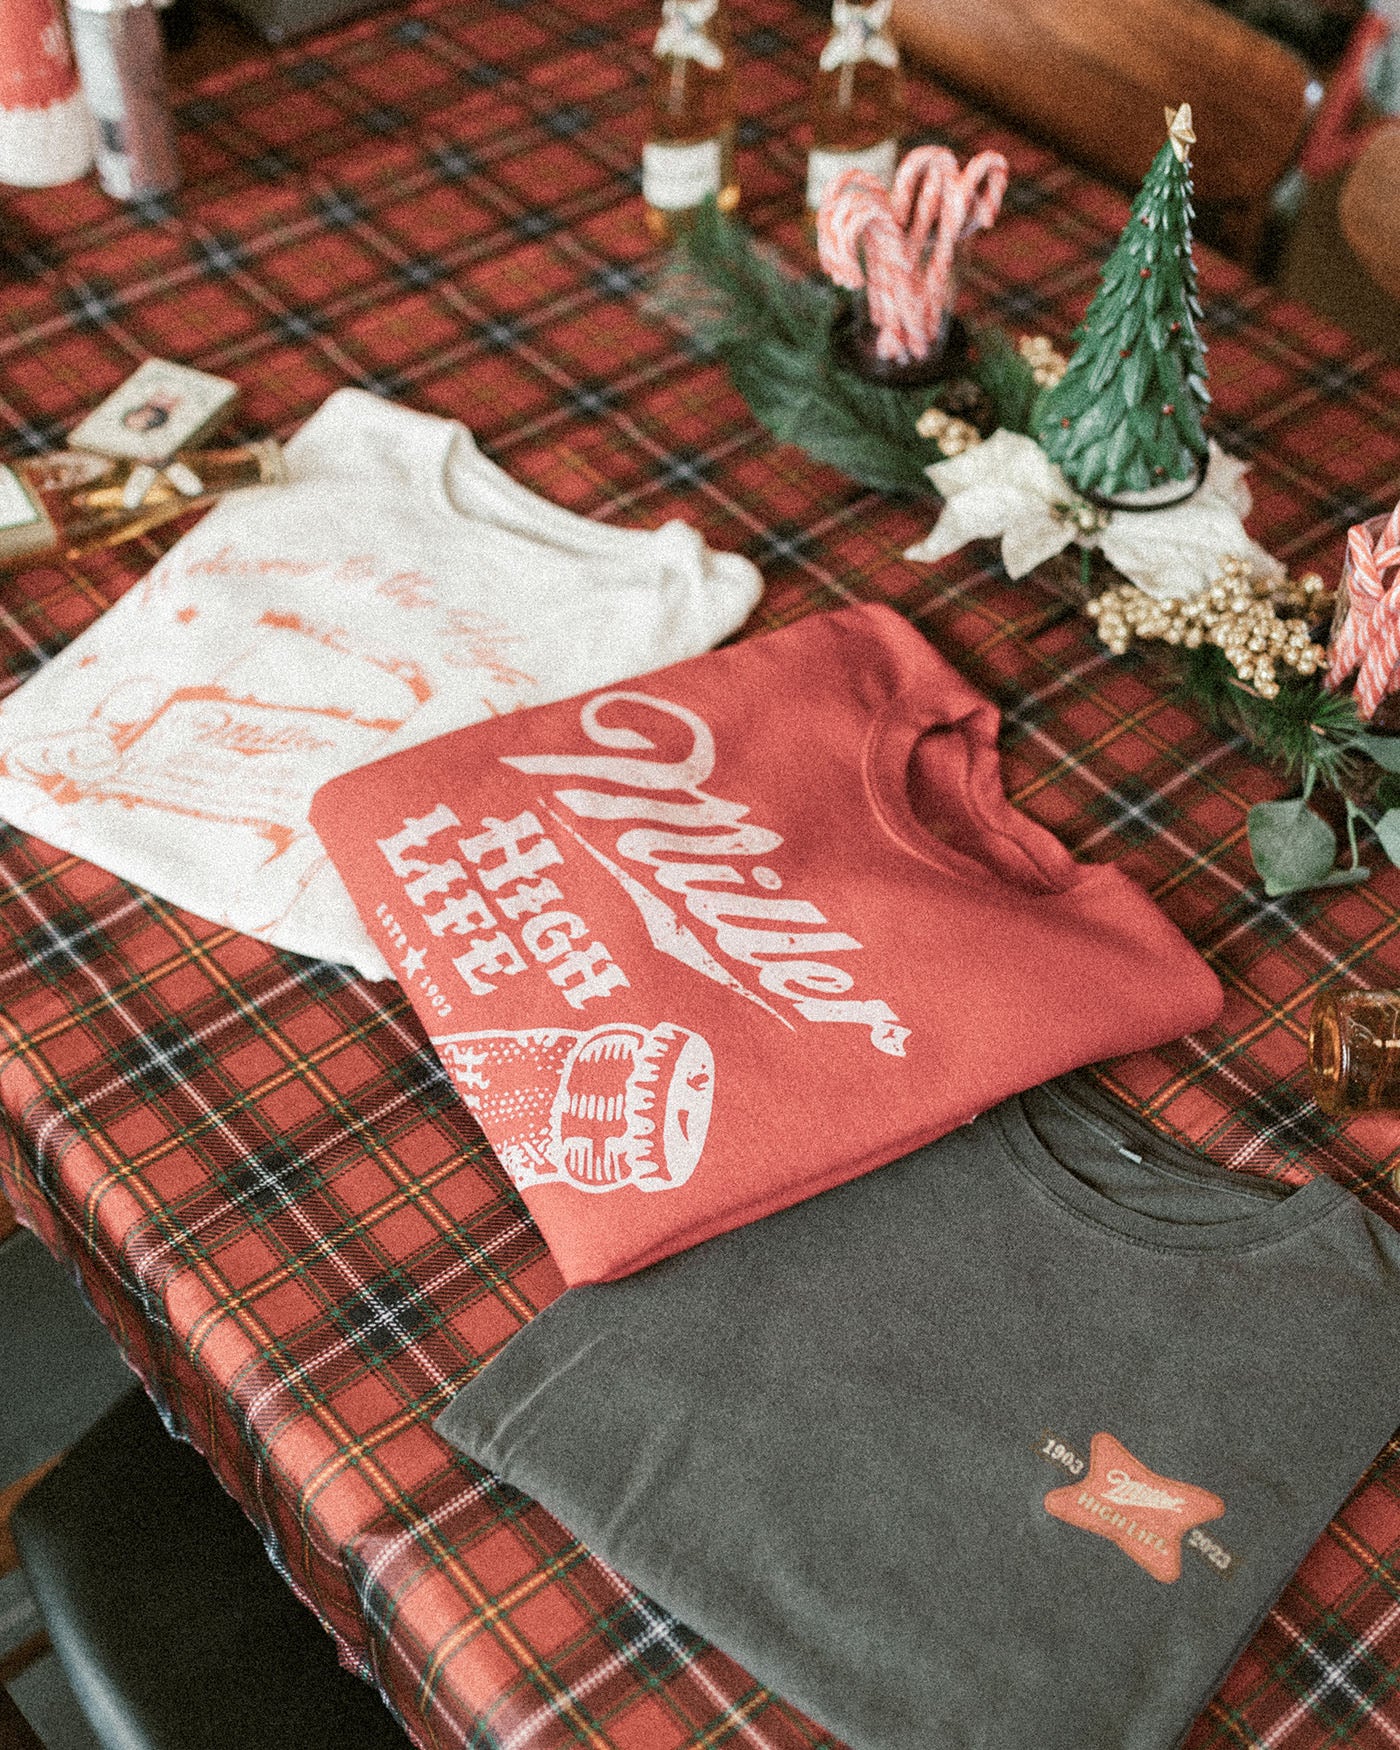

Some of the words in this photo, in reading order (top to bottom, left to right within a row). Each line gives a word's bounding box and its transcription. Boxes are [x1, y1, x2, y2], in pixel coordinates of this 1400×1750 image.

[375, 804, 528, 996] LIFE
[499, 691, 914, 1057] Miller
[457, 811, 631, 1010] HIGH
[420, 976, 453, 1017] 1903
[1042, 1439, 1084, 1475] 1903
[1101, 1469, 1187, 1513] Miller
[1077, 1492, 1127, 1529] HIGH
[1127, 1521, 1168, 1556] LIFE
[1189, 1529, 1232, 1569] 2023
